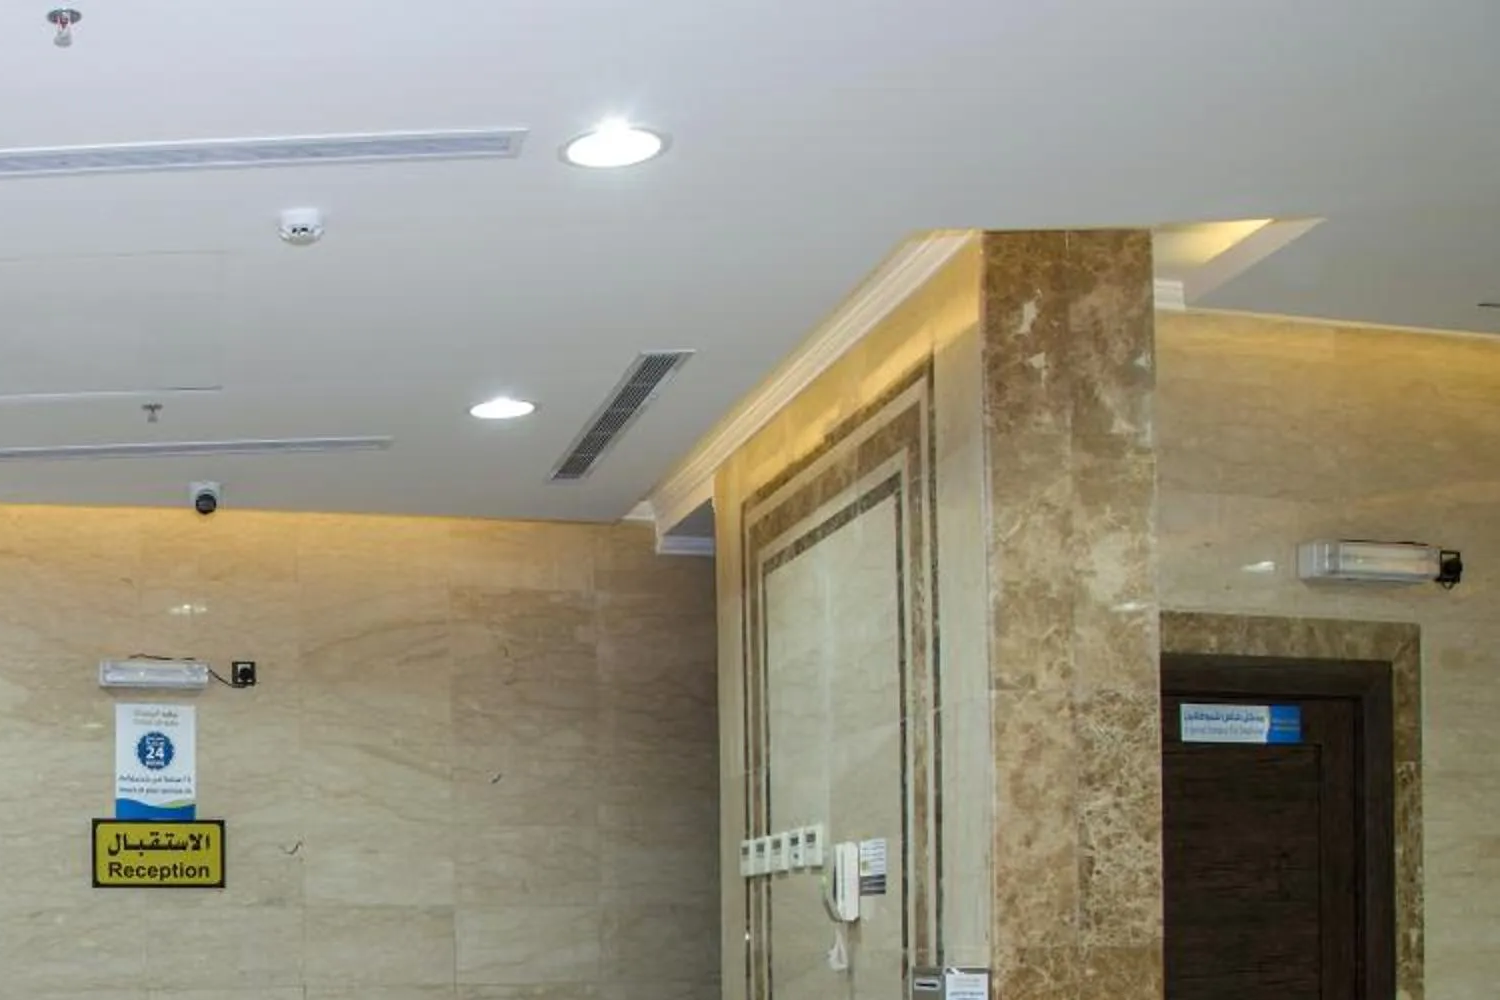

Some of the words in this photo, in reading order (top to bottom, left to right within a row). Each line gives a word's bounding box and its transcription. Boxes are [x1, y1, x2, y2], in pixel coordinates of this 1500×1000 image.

[145, 746, 165, 759] 24
[107, 831, 211, 857] الاستقبال
[108, 861, 210, 882] Reception
